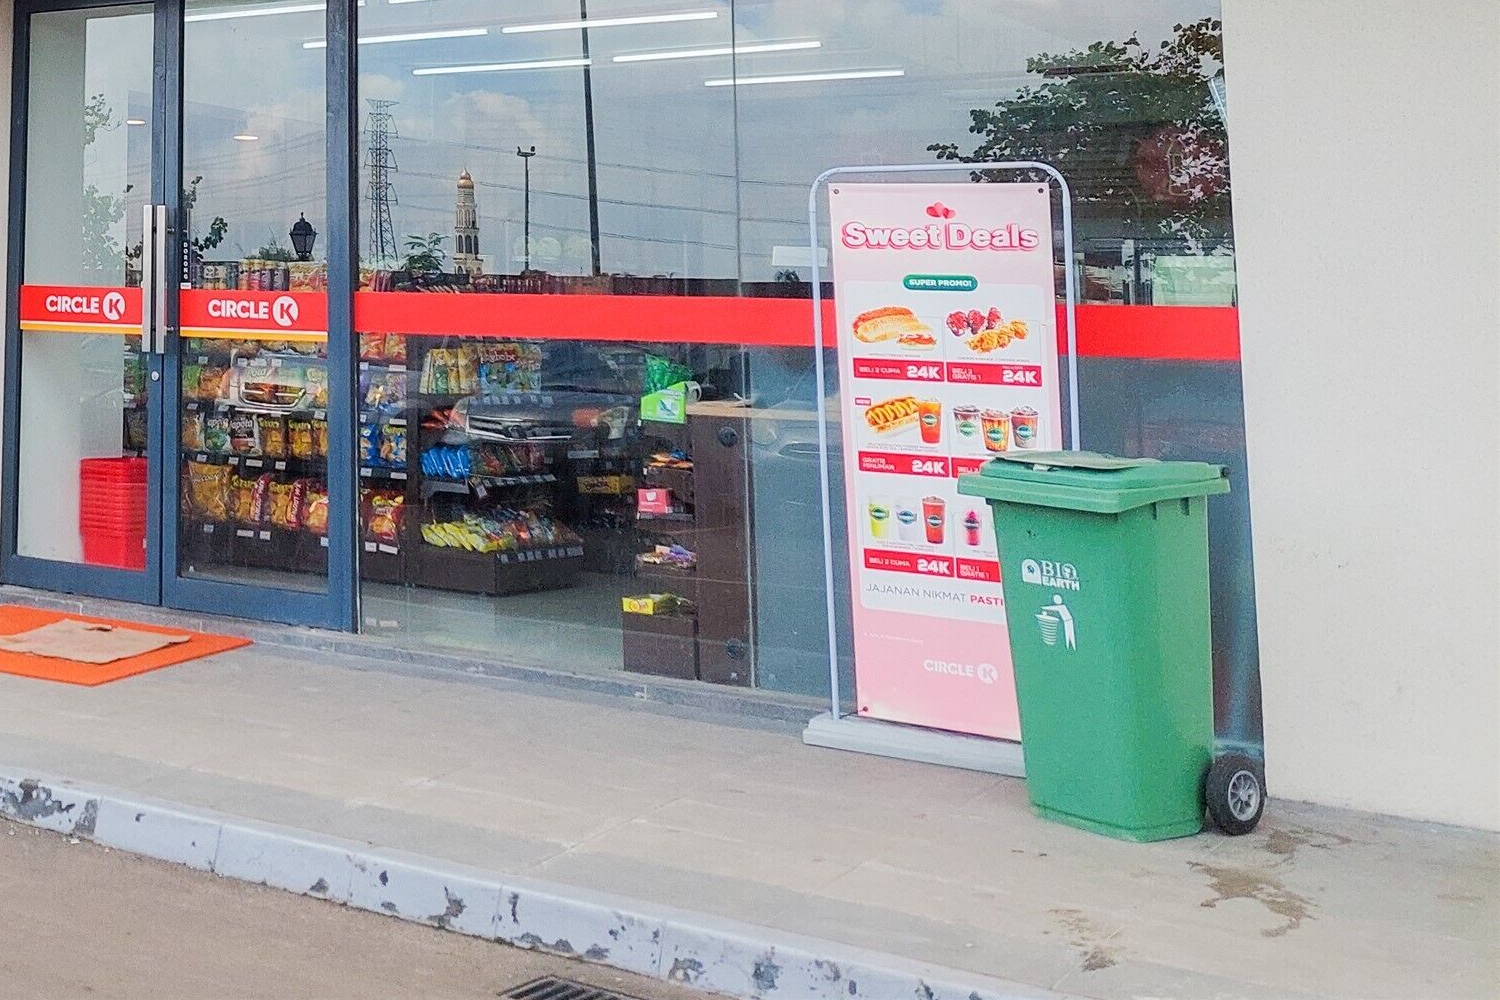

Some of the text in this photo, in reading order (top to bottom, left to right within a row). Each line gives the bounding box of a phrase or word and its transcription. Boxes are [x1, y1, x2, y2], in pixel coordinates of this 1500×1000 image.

[842, 221, 1039, 251] Sweet Deals
[908, 279, 973, 288] SUPER PROMO!
[45, 294, 100, 314] CIRCLE
[208, 298, 270, 320] CIRCLE
[906, 365, 941, 380] 24K
[1002, 369, 1038, 384] 24K
[911, 459, 946, 475] 24K
[916, 558, 951, 575] 24K
[1042, 576, 1080, 591] EARTH
[866, 583, 1004, 607] JAJANAN NIKMAT PASTI
[923, 659, 997, 684] CIRCLE K
